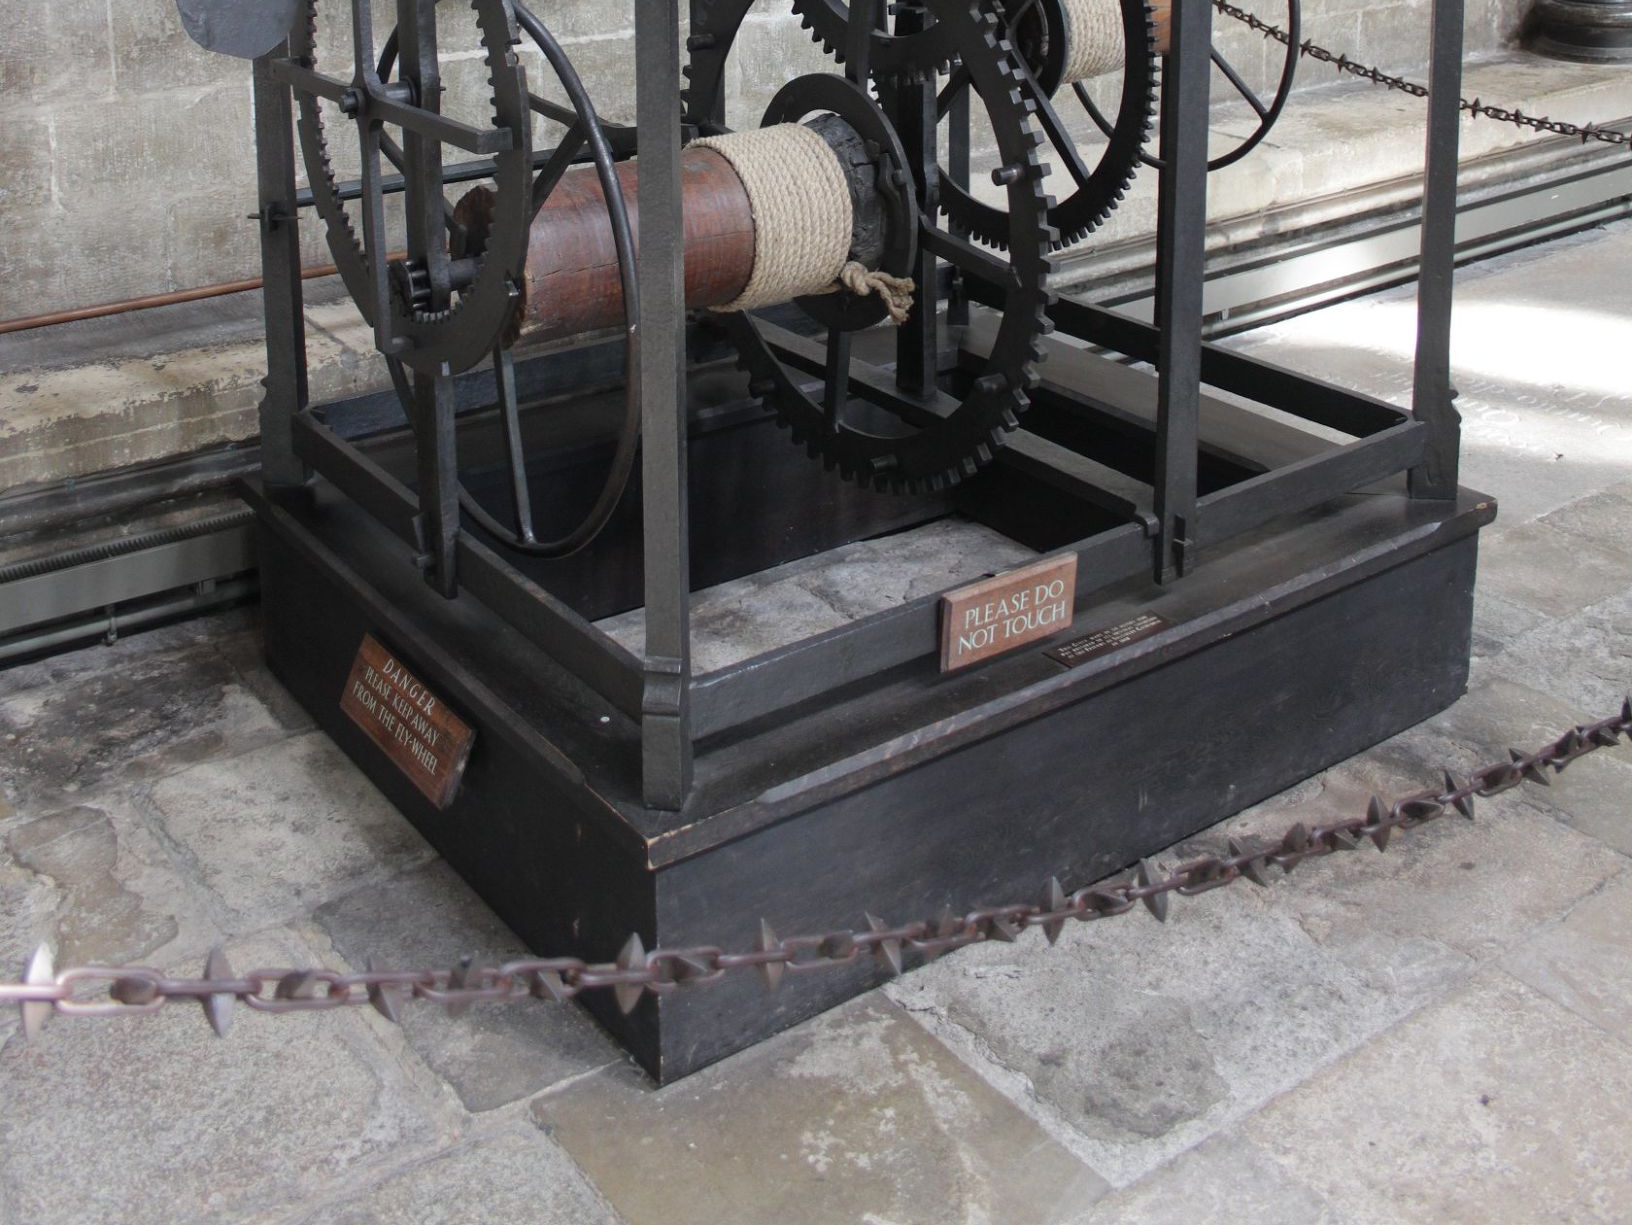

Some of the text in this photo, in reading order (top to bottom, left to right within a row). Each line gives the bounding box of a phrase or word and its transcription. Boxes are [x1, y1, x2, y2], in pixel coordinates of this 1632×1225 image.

[958, 626, 1002, 655] NOT
[1003, 600, 1066, 639] TOUCH
[964, 579, 1065, 629] PLEASE DO
[365, 666, 441, 747] PLEASE KEEP AWAY
[383, 658, 436, 717] DANGER
[353, 680, 439, 777] FROM THE FLY-WHEEL
